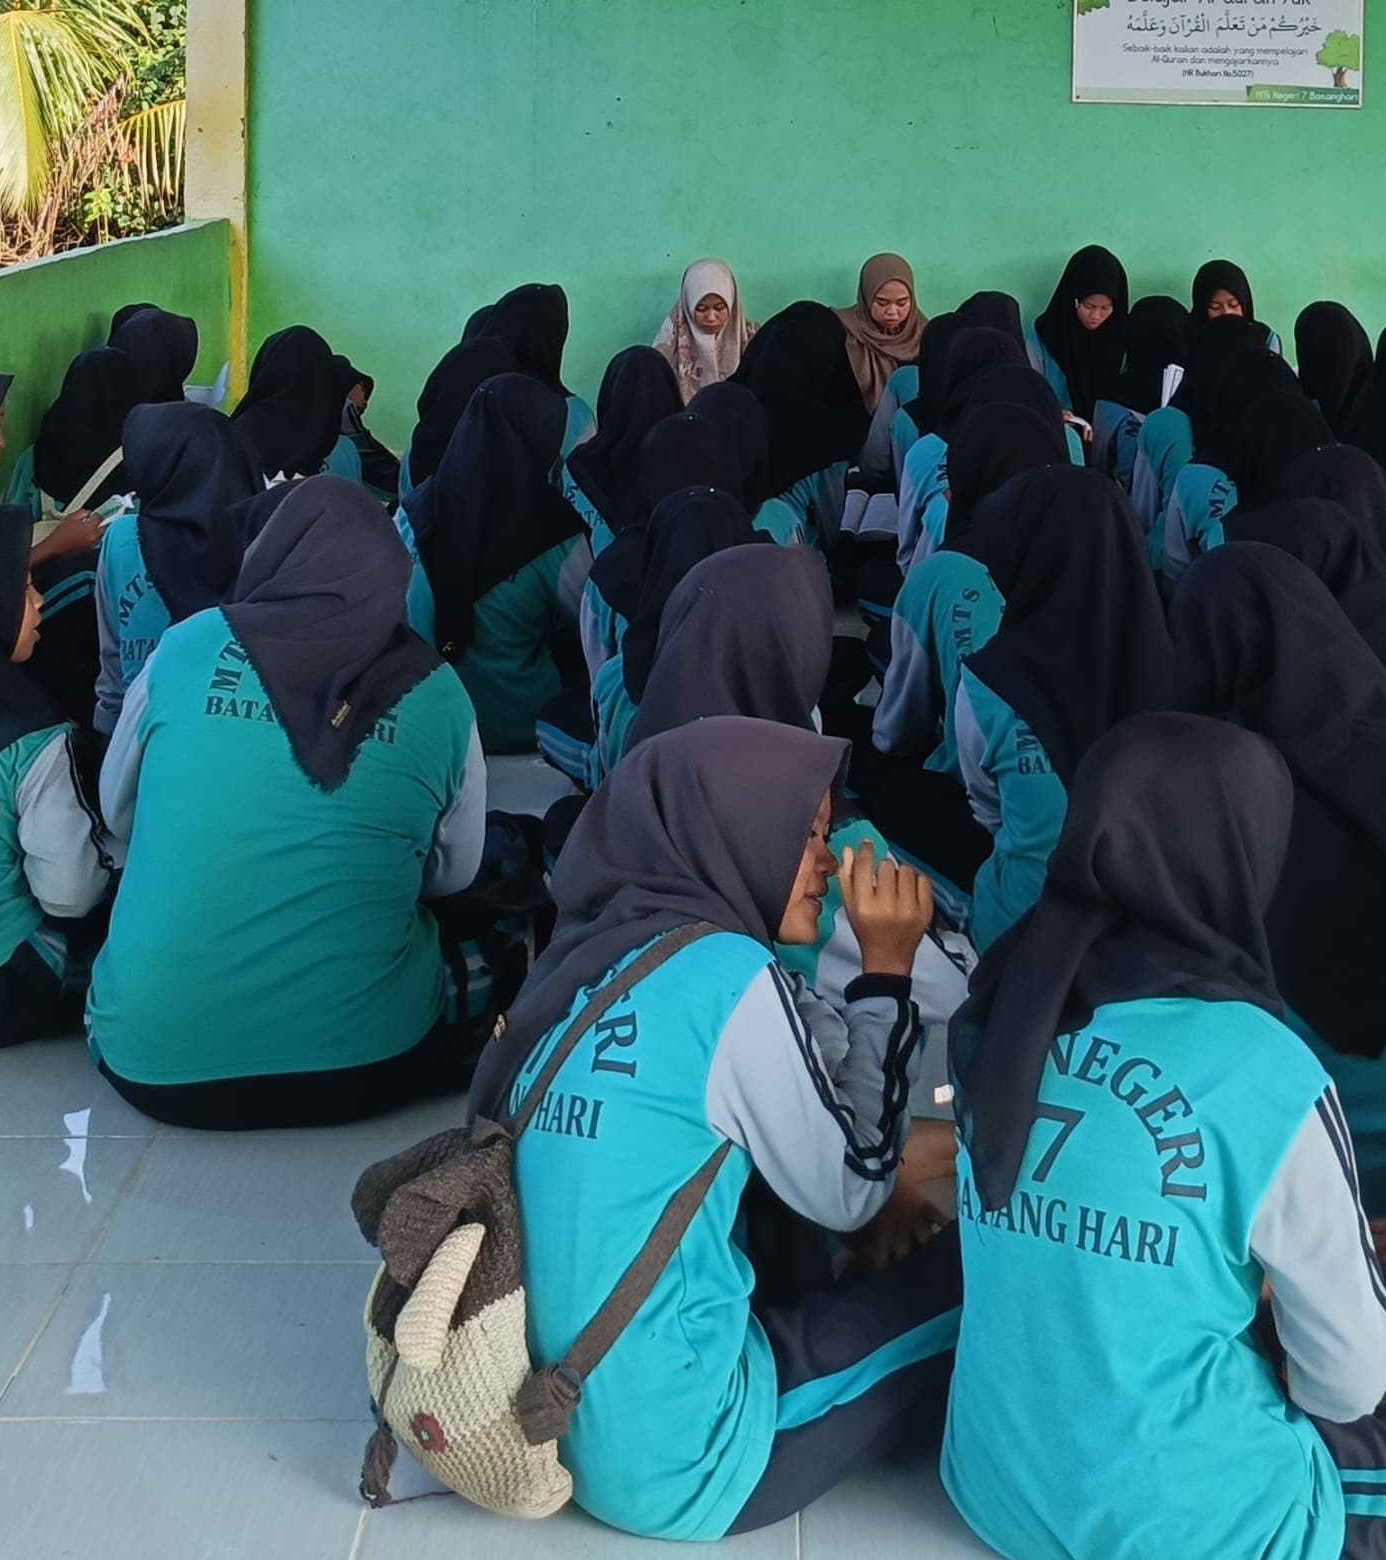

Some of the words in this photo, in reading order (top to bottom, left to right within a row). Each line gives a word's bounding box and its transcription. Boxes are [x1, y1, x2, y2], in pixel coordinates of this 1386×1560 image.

[1123, 43, 1172, 54] Sebaik-baik
[1174, 44, 1199, 54] kalian
[1201, 45, 1231, 55] adalah
[1234, 47, 1254, 56] yang
[1151, 55, 1188, 65] Al-Quran
[1190, 56, 1206, 65] dan
[1208, 478, 1233, 519] MT
[209, 640, 250, 694] MT
[205, 696, 276, 723] BATA
[373, 723, 396, 744] RI
[534, 1091, 604, 1140] HARI
[1048, 1031, 1207, 1202] NEGERI
[1031, 1101, 1086, 1183] 7
[1076, 1205, 1180, 1267] HARI
